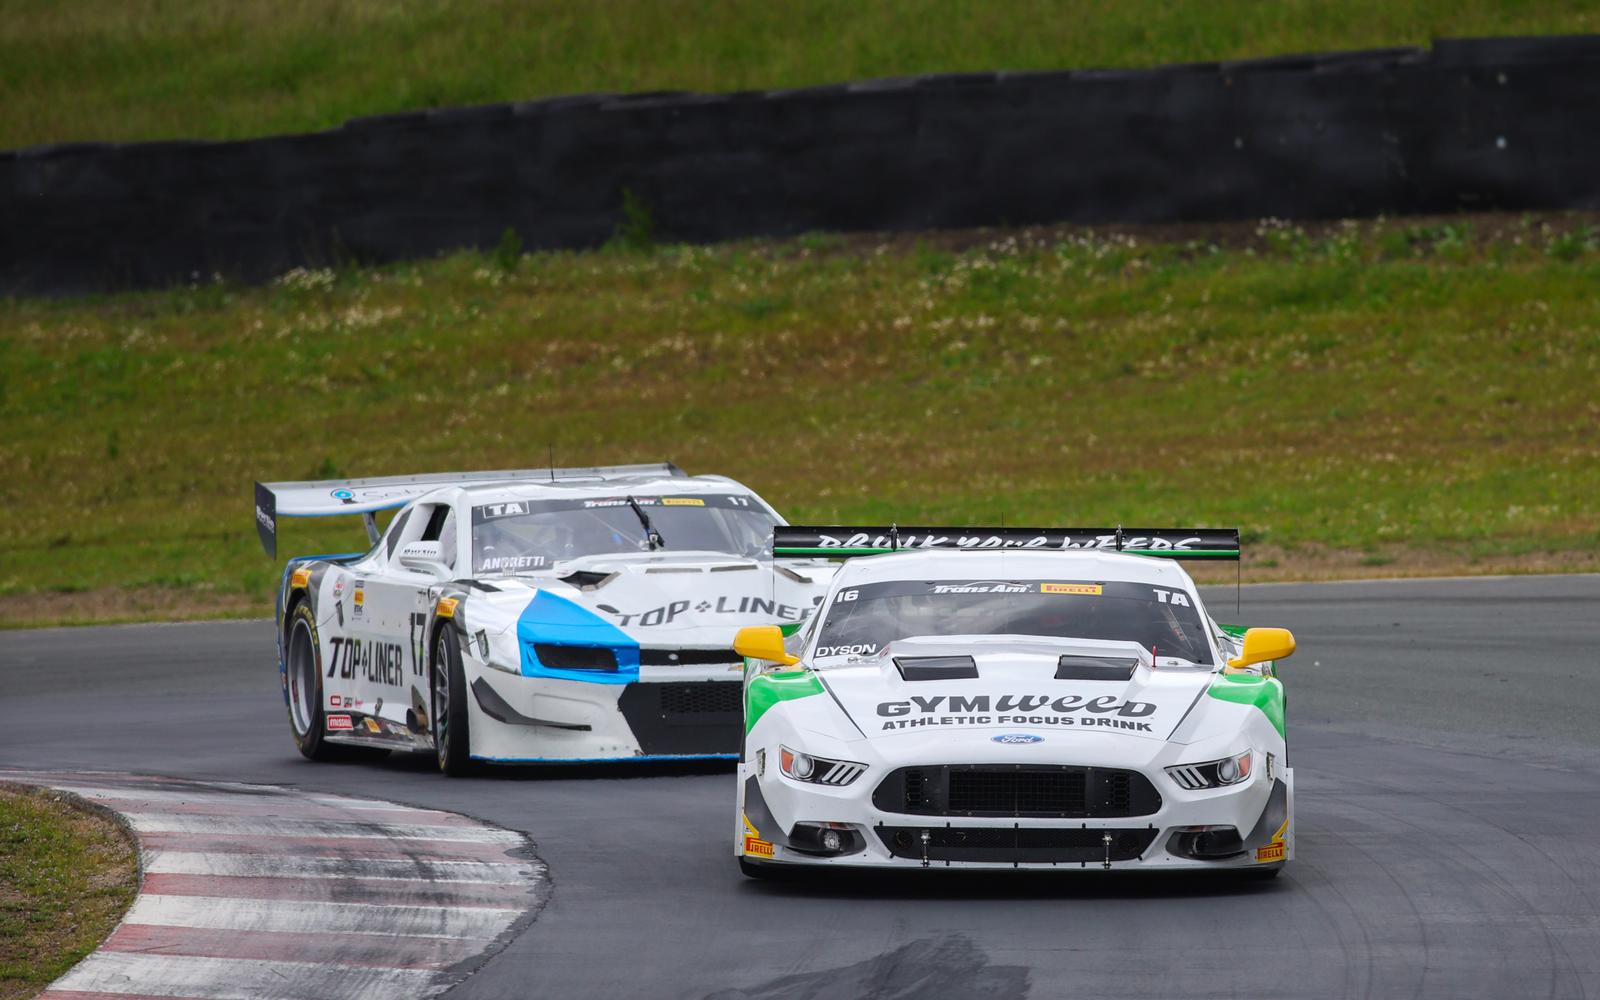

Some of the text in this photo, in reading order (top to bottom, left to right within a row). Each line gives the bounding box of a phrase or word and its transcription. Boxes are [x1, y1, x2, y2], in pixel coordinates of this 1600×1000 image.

[488, 503, 524, 515] TA
[482, 556, 545, 570] ANDRETTI
[933, 583, 1030, 594] Trans Am
[837, 590, 859, 603] 16
[1153, 589, 1190, 607] TA
[614, 600, 690, 627] TOP
[410, 612, 427, 677] 17
[815, 644, 877, 657] DYSON
[327, 636, 403, 687] TOP LINER
[882, 716, 1153, 732] ATHLETIC FOCUS DRINK
